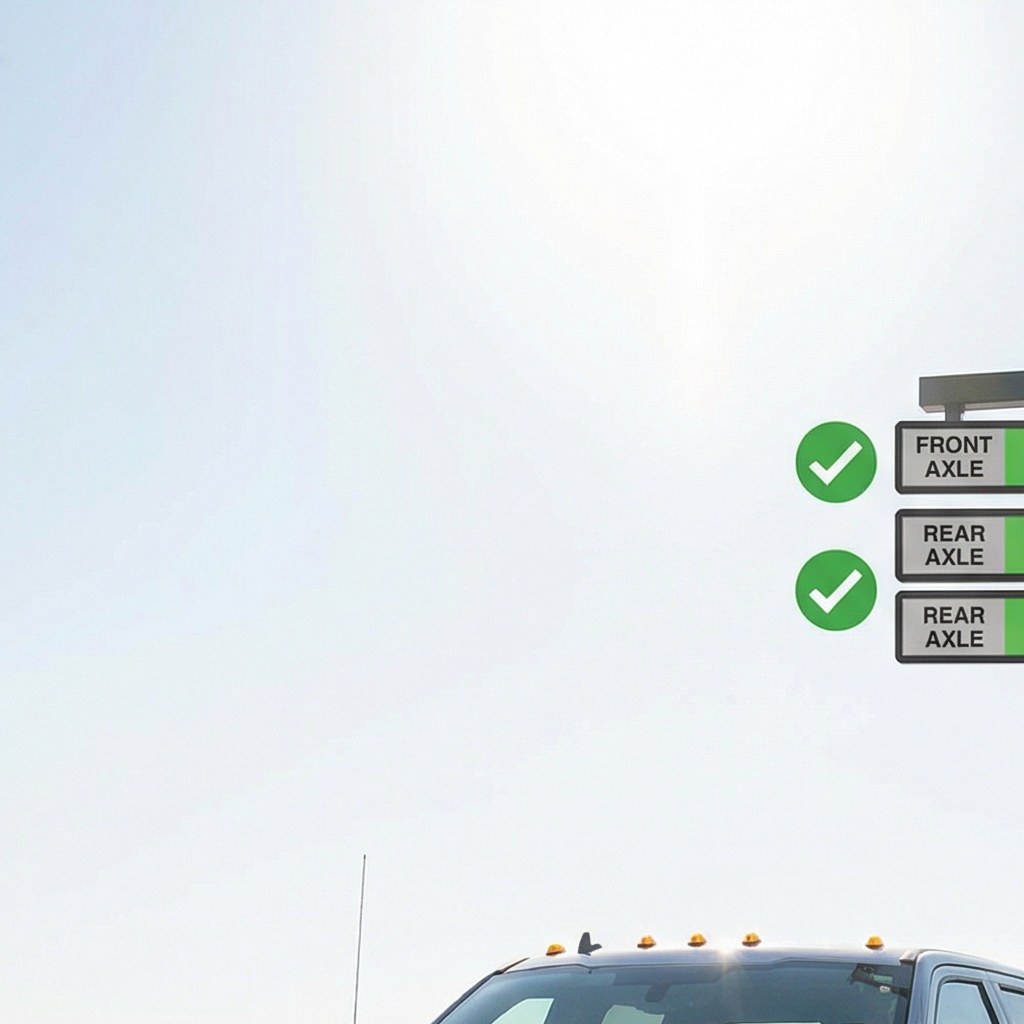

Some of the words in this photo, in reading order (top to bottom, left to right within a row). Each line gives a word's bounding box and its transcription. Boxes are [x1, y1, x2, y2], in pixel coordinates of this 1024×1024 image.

[916, 435, 993, 454] FRONT
[924, 459, 984, 478] AXLE
[923, 524, 986, 543] REAR
[924, 547, 984, 566] AXLE
[923, 606, 985, 625] REAR
[925, 629, 984, 648] AXLE
